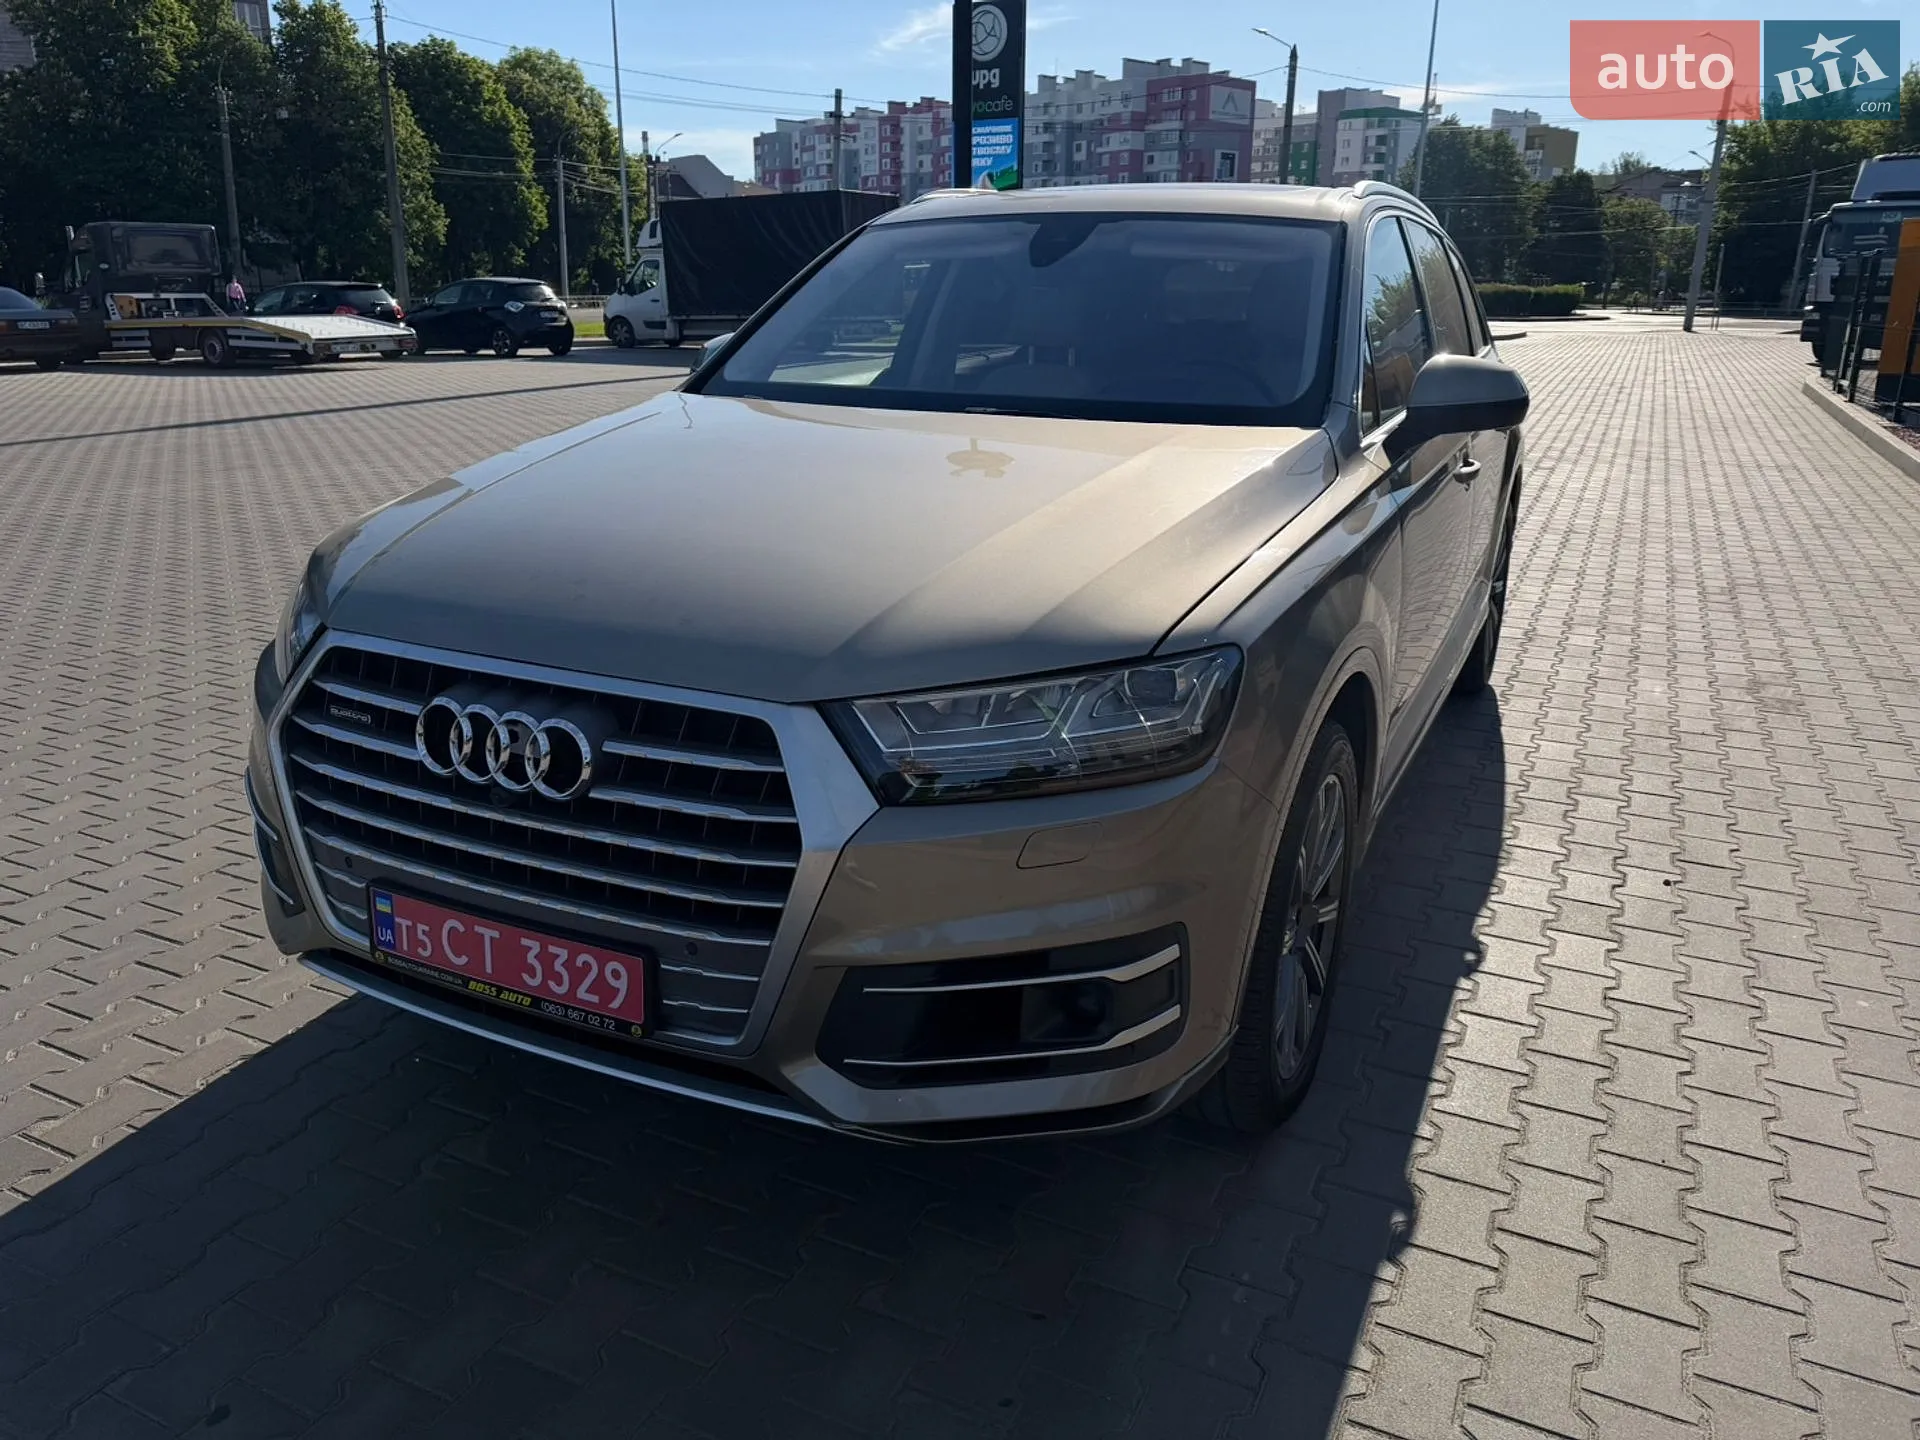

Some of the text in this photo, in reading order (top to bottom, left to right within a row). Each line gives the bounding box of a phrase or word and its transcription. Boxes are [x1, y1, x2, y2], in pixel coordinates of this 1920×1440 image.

[972, 68, 1000, 89] upg
[377, 927, 394, 944] UA
[395, 917, 629, 1010] T5 CT 3329
[540, 1000, 566, 1018] (063)
[567, 1007, 586, 1022] 667
[587, 1014, 601, 1027] 02
[602, 1017, 616, 1031] 72
